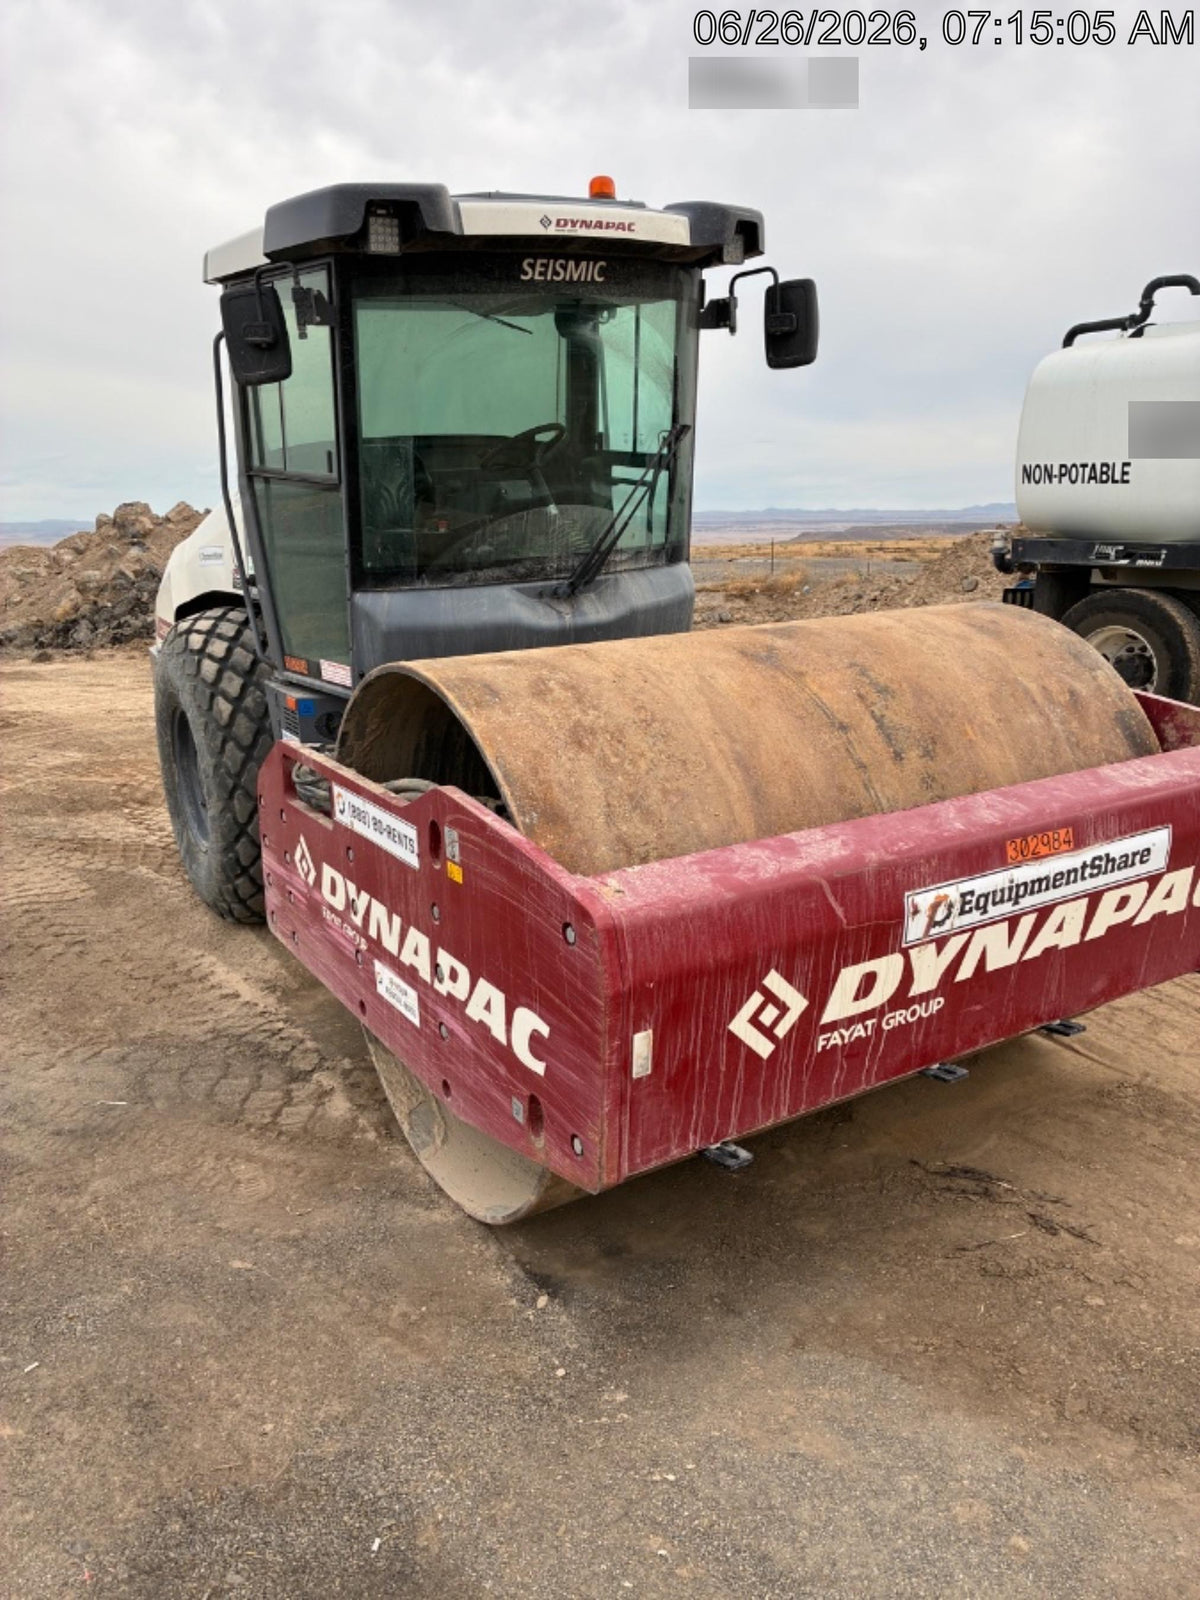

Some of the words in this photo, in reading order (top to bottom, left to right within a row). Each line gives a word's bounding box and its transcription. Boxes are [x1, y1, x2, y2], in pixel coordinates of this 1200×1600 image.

[555, 218, 636, 232] DYNAPAC
[520, 258, 607, 282] SEISMIC
[1021, 461, 1132, 485] NON-POTABLE
[1009, 829, 1073, 861] 302984
[957, 846, 1152, 917] EquipmentShare
[819, 865, 1200, 1025] DYNAPA
[321, 861, 550, 1077] DYNAPAC
[817, 1018, 877, 1053] FAYAT
[881, 996, 945, 1031] GROUP
